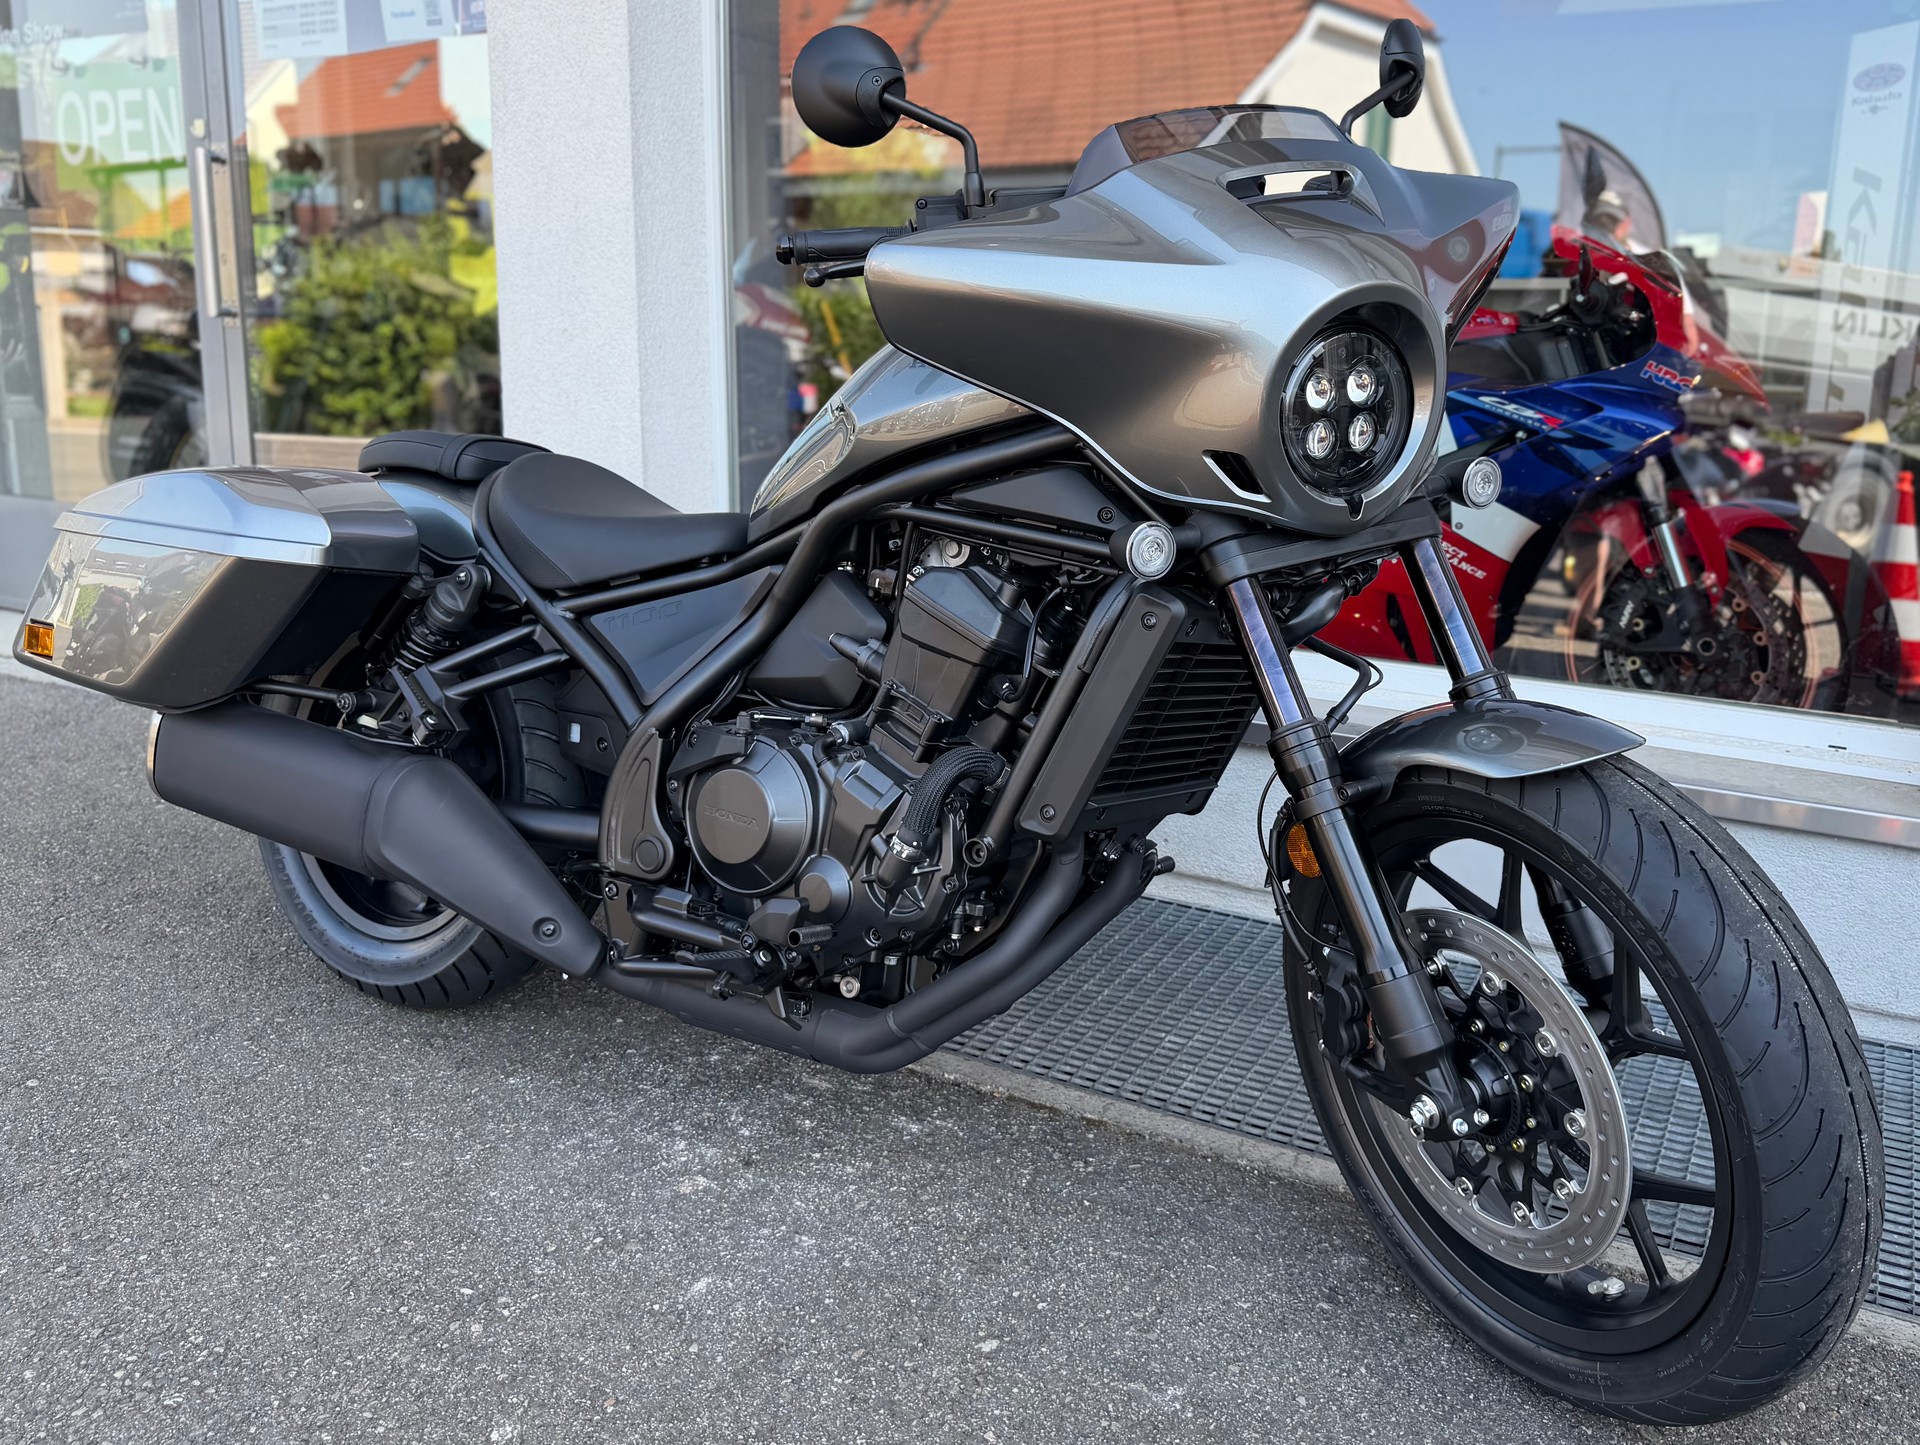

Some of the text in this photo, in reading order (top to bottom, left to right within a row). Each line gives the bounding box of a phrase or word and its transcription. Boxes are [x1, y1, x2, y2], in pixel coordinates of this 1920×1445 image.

[57, 87, 186, 167] OPEN
[1640, 360, 1695, 395] HRC
[603, 600, 682, 633] 1100
[703, 804, 760, 830] HONDA
[1574, 860, 1681, 980] DUNLOP
